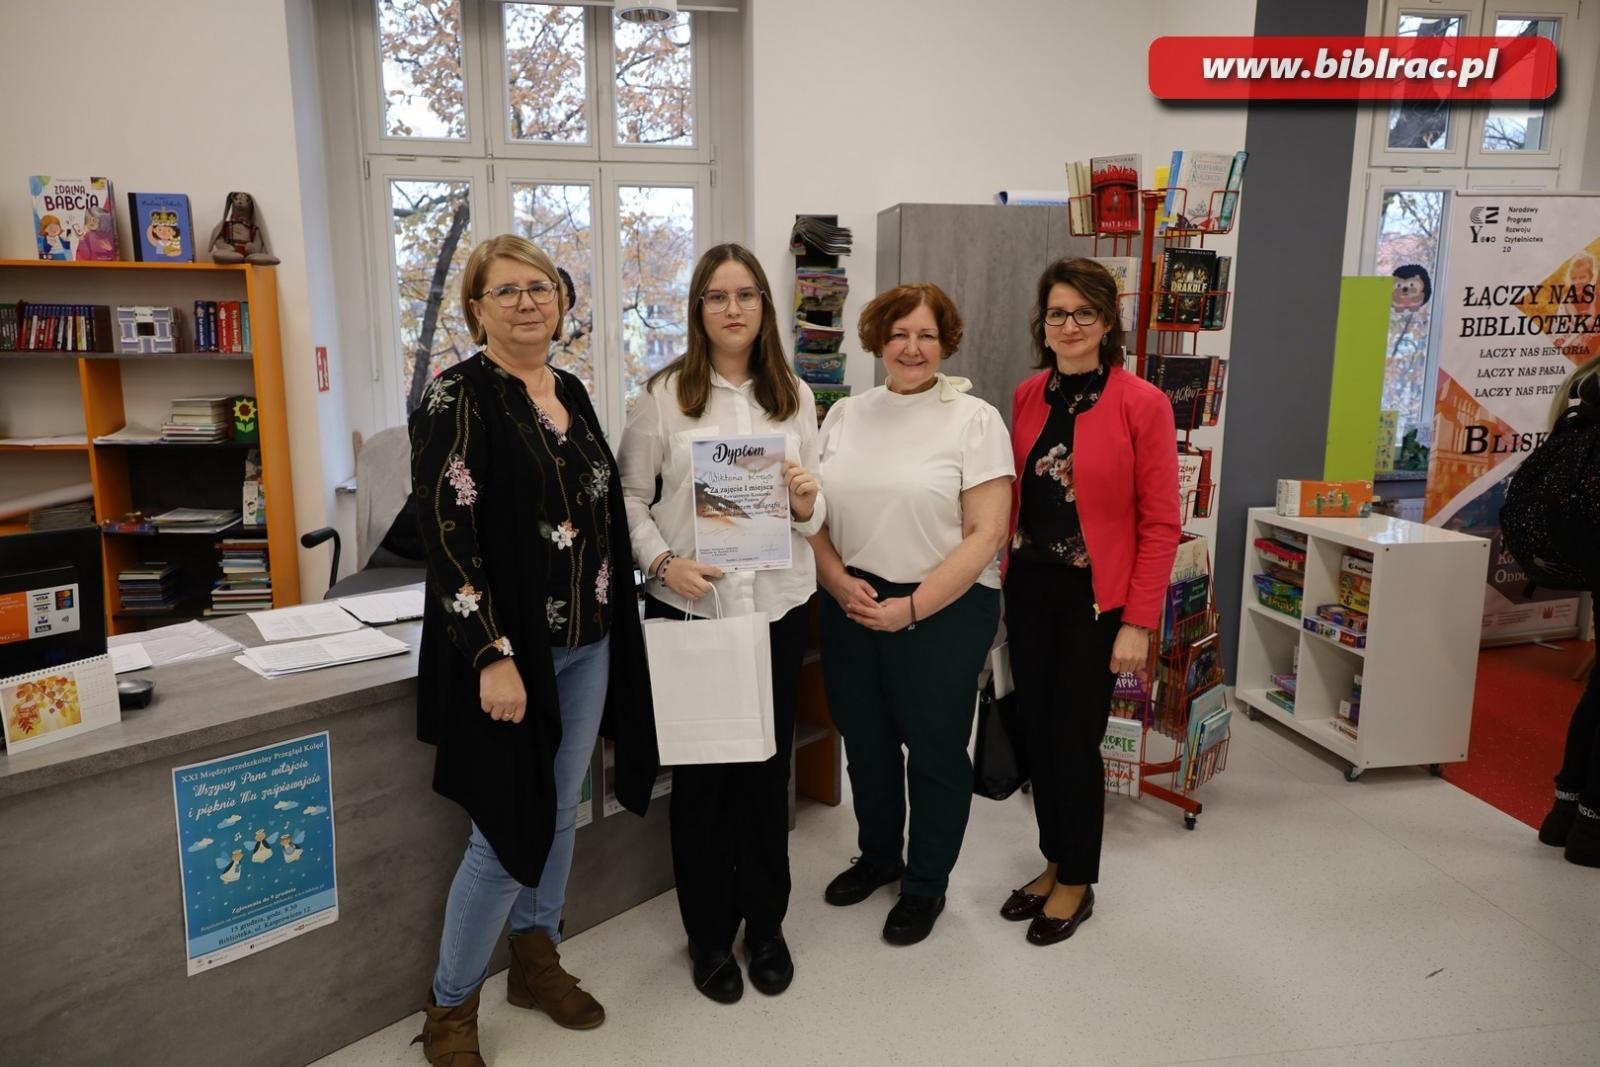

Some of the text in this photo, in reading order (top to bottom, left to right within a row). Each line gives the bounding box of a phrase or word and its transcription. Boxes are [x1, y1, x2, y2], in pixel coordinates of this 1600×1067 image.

[54, 185, 86, 196] ZDALNA
[1508, 206, 1539, 214] Narodowy
[1506, 216, 1532, 224] Program
[1506, 226, 1531, 234] Rozwoju
[1504, 236, 1543, 244] Czytelnictwa
[1463, 284, 1596, 310] ŁĄCZY NAS
[1480, 345, 1590, 360] ŁĄCZY NAS HISTORIA
[1477, 366, 1566, 379] ŁĄCZY NAS PASJA
[1474, 385, 1561, 398] ŁĄCZY NAS PRZY
[1462, 425, 1551, 455] BLISK
[712, 443, 766, 466] Dyplom
[710, 486, 718, 494] Za
[181, 774, 198, 784] XXI
[193, 759, 309, 798] Wszyscy Pana witajcie
[187, 772, 320, 822] i pięknie Mu zaśpiewajcie
